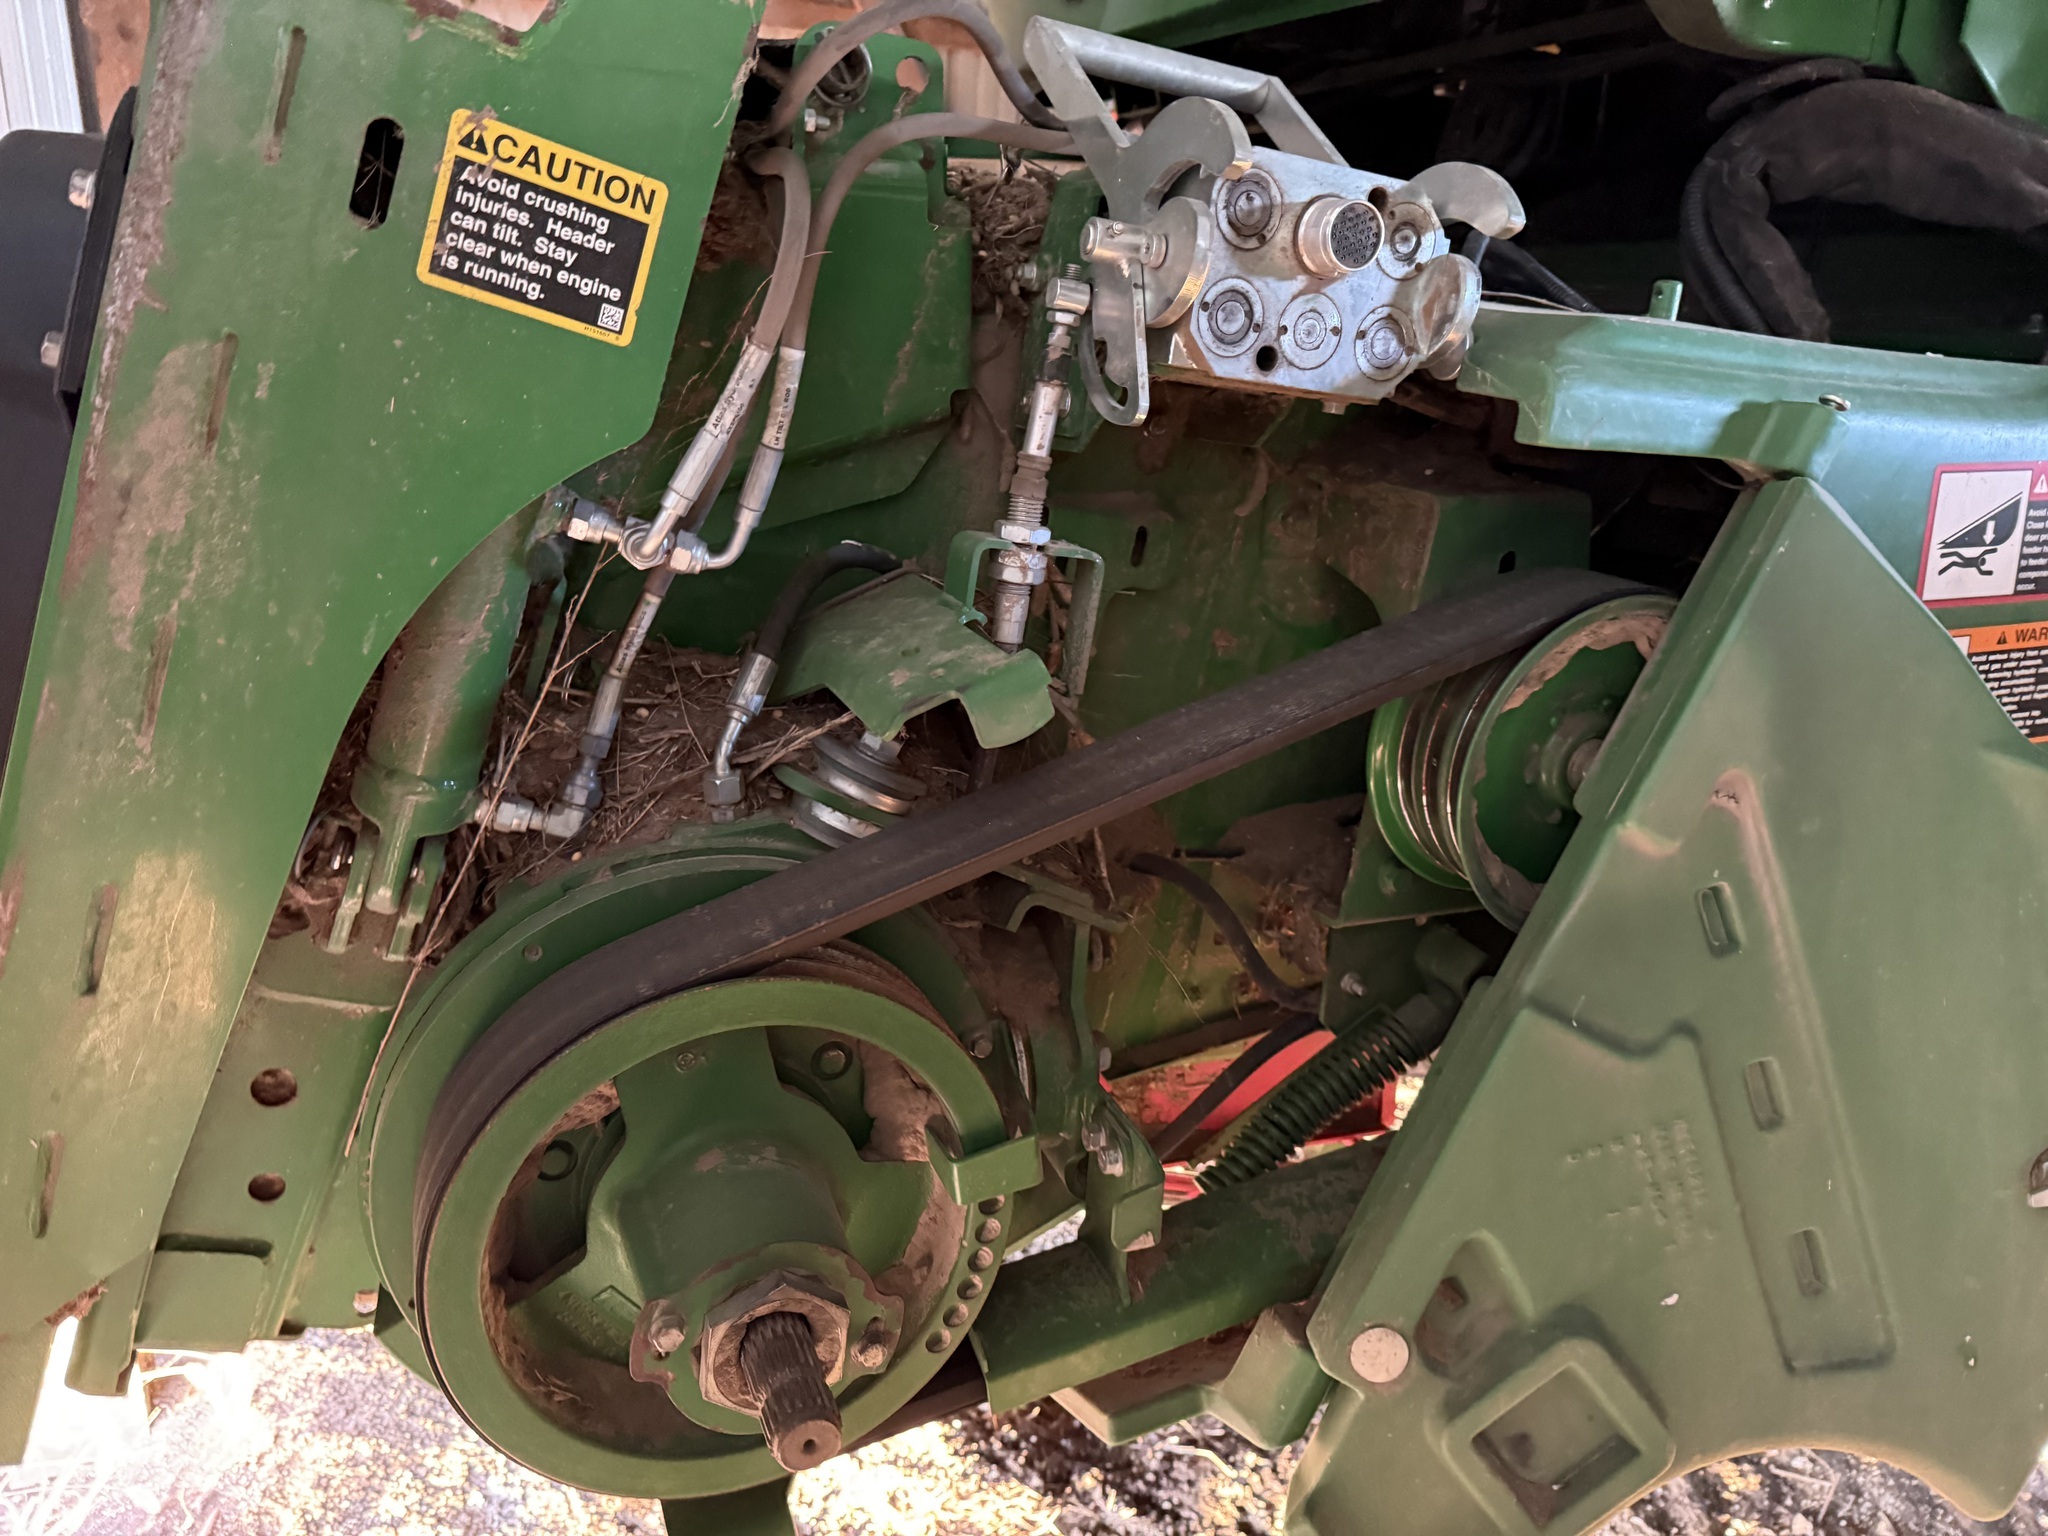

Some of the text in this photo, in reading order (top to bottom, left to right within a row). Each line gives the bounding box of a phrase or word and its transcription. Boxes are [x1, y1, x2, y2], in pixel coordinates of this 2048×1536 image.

[460, 165, 610, 235] Avoid crushing
[493, 134, 656, 215] CAUTION
[450, 211, 579, 268] can tilt. Stay
[455, 185, 616, 255] injuries. Header
[440, 248, 545, 301] is running.
[445, 232, 622, 302] clear when engine
